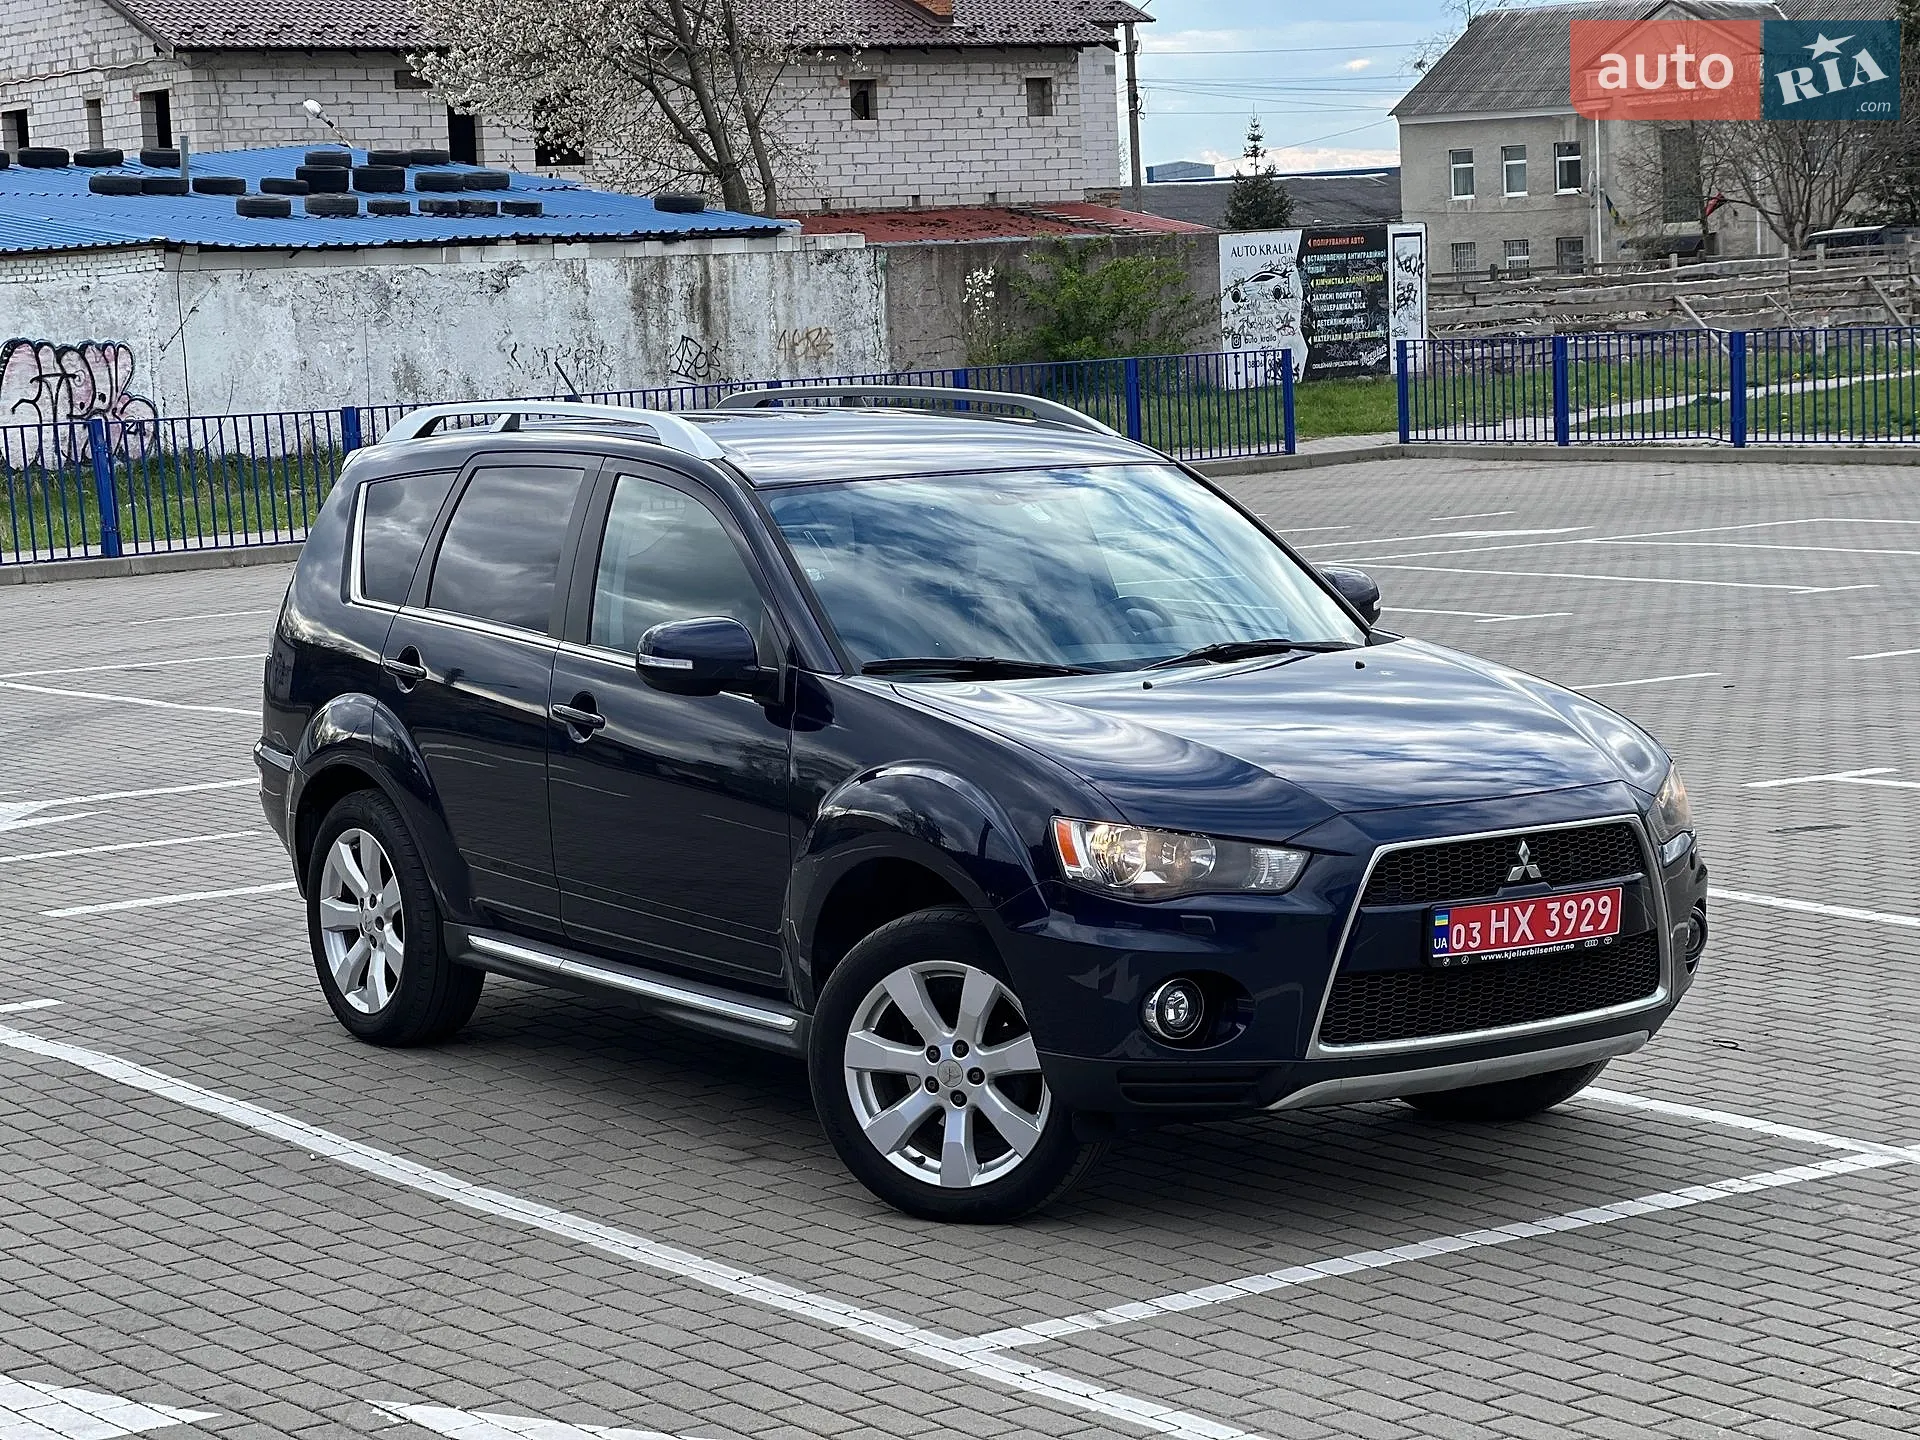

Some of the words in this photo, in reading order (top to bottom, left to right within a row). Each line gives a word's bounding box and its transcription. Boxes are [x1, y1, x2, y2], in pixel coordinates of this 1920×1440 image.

[1312, 237, 1350, 247] ПОЛІРУВАННЯ
[1350, 236, 1365, 244] АВТО
[1230, 245, 1257, 258] AUTO
[1259, 243, 1293, 256] KRALIA
[1307, 253, 1346, 262] ВСТАНОВЛЕННЯ
[1347, 249, 1386, 259] АНТИГРАВІЙНОЇ
[1315, 277, 1344, 286] ХІМЧИСТКА
[1312, 292, 1335, 300] ЗАХИСНІ
[1335, 290, 1362, 299] ПОКРИТТЯ
[1313, 333, 1342, 343] МАТЕРІАЛИ
[1451, 922, 1481, 950] 03
[1489, 904, 1535, 944] HX
[1545, 895, 1612, 938] 3929
[1433, 938, 1448, 950] UA
[1480, 942, 1575, 961] www.kjellerbilsenter.no
